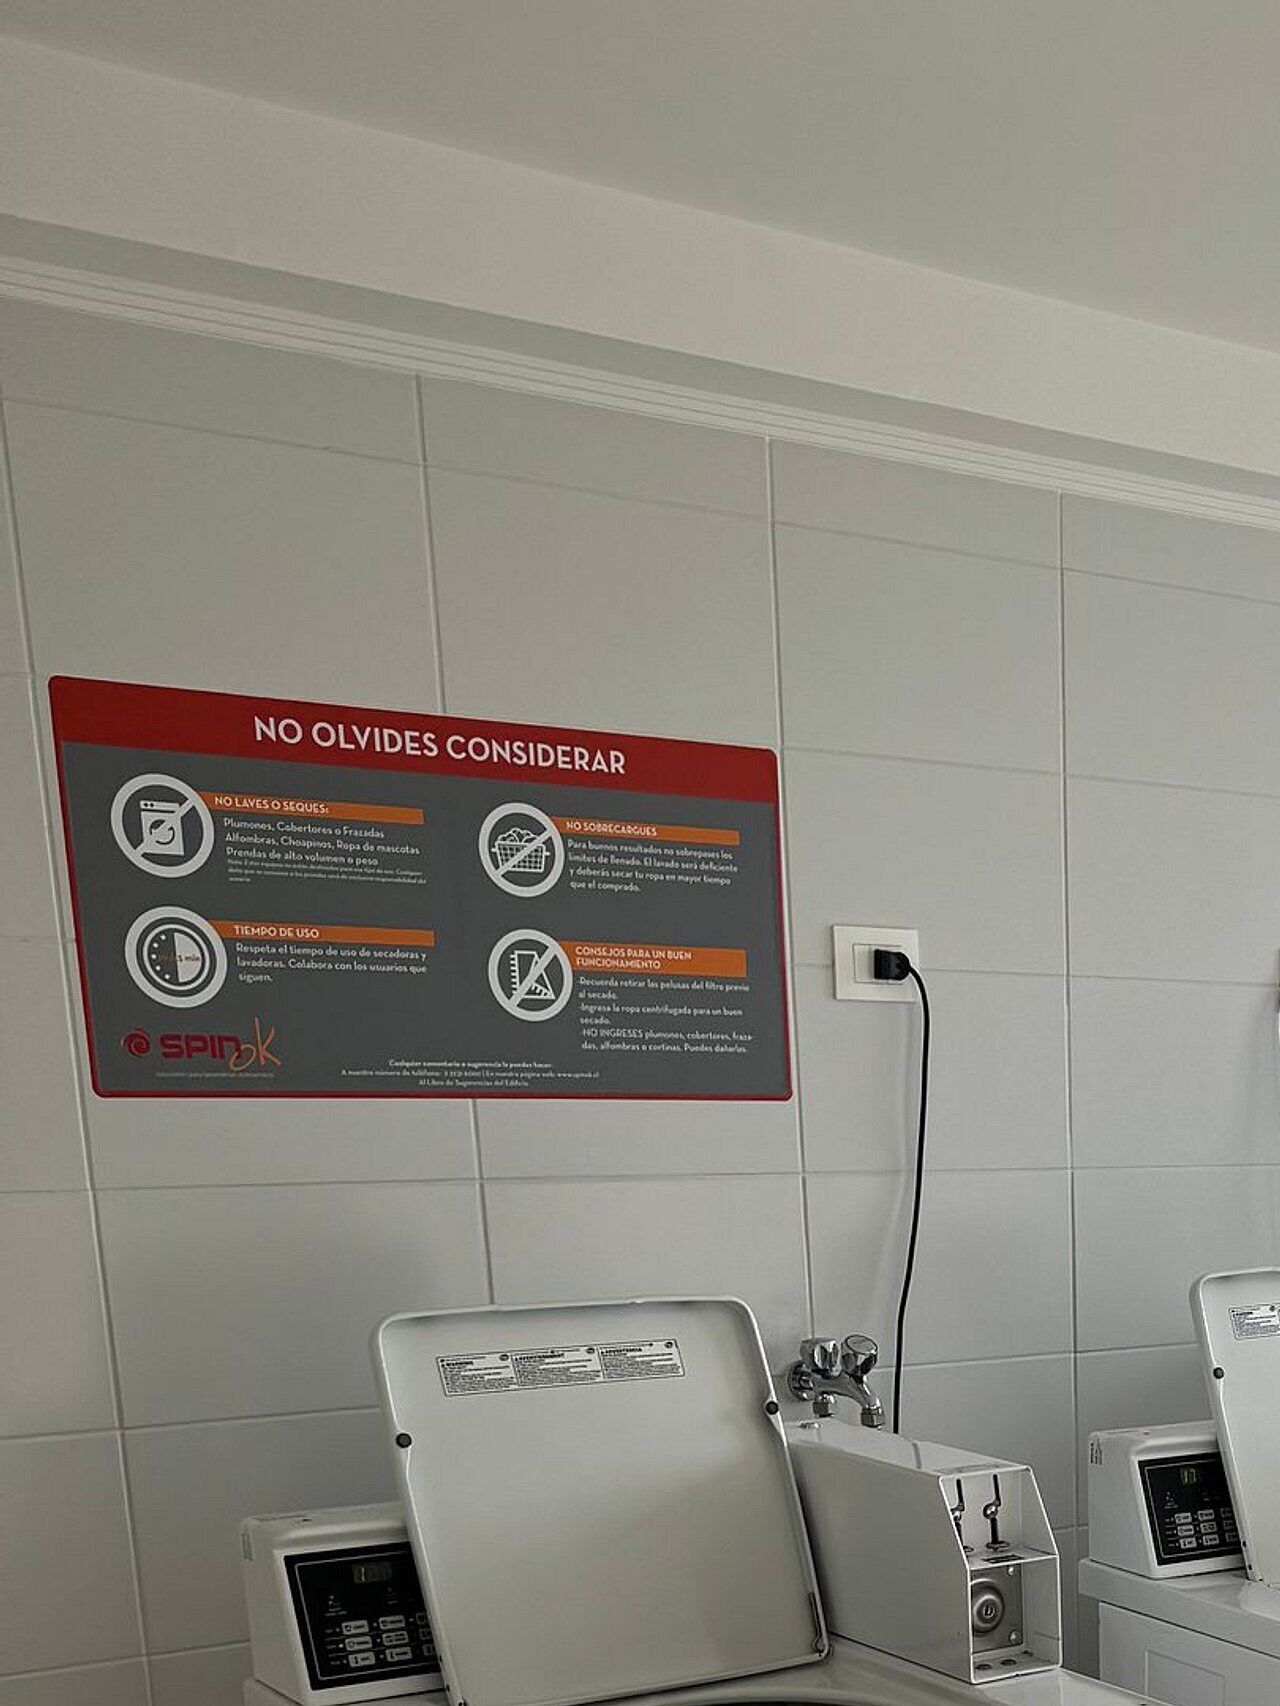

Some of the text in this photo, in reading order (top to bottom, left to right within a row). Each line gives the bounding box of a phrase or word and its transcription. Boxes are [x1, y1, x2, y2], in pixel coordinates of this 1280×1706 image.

[254, 716, 626, 775] NO OLVIDES CONSIDERAR
[214, 796, 233, 807] NO
[235, 797, 270, 809] LAVES
[271, 800, 281, 810] O
[276, 821, 333, 835] Cobertores
[334, 828, 341, 836] o
[343, 826, 385, 838] Frazadas
[565, 821, 658, 837] NO SOBRECARGUES
[336, 840, 360, 852] Ropa
[362, 842, 375, 852] de
[376, 844, 420, 855] mascotas
[567, 839, 733, 860] Para buenos resultados no sobrepases los
[226, 846, 267, 859] Prendas
[268, 848, 282, 859] de
[284, 850, 303, 861] alto
[305, 852, 346, 863] volumen
[347, 856, 354, 864] o
[355, 857, 379, 867] peso
[598, 853, 609, 864] de
[643, 856, 652, 867] El
[653, 858, 680, 869] lavado
[699, 861, 738, 873] deficiente
[570, 881, 586, 890] que
[588, 879, 596, 889] el
[611, 869, 633, 878] secar
[635, 870, 644, 879] tu
[645, 873, 665, 882] ropa
[665, 873, 676, 882] en
[677, 875, 702, 885] mayor
[703, 875, 732, 887] tiempo
[234, 925, 319, 939] TIEMPO DE USO
[235, 942, 427, 962] Respeta el tiempo de uso de secadoras y
[575, 946, 692, 960] CONSEJOS PARA UN BUEN
[288, 958, 333, 970] Colabora
[334, 962, 352, 970] con
[353, 960, 368, 971] los
[369, 963, 408, 972] usuarios
[409, 965, 428, 975] que
[576, 957, 662, 970] FUNCIONAMIENTO
[620, 979, 646, 988] retirar
[647, 979, 659, 988] las
[660, 980, 690, 991] pelusas
[691, 980, 704, 989] del
[705, 981, 724, 991] filtro
[725, 983, 750, 992] previo
[579, 989, 586, 999] al
[612, 1003, 620, 1012] la
[621, 1006, 640, 1015] ropa
[642, 1003, 691, 1016] centrifugada
[692, 1007, 711, 1017] para
[722, 1006, 743, 1016] buen
[600, 1028, 643, 1039] INGRESES
[600, 1041, 640, 1051] alfombras
[684, 1043, 713, 1053] Puedes
